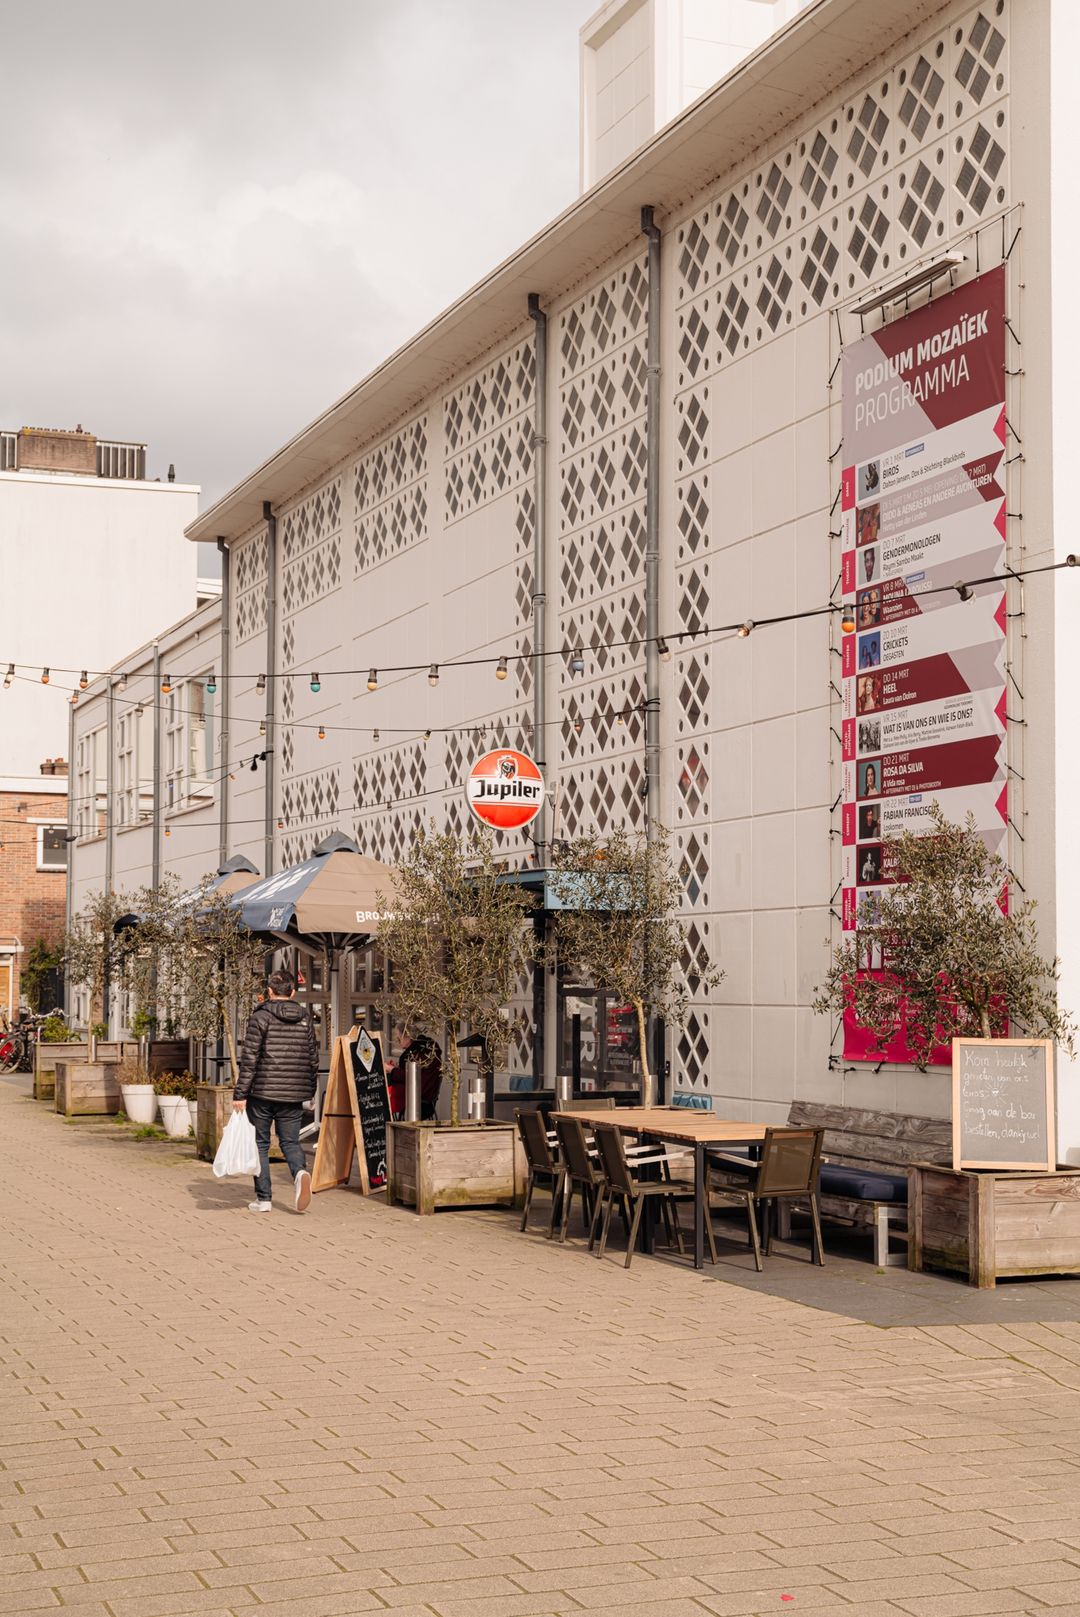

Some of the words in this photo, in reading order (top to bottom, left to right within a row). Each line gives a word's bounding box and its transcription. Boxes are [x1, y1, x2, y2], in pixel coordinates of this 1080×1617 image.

[856, 347, 913, 396] PODIUM
[917, 309, 988, 366] MOZAÏEK
[855, 354, 970, 431] PROGRAMMA
[924, 460, 943, 473] Stichting
[924, 496, 932, 508] EN
[932, 486, 955, 505] ANDERE
[955, 473, 993, 495] AVONTUREN
[883, 533, 941, 560] GENDERMONOLOGEN
[883, 636, 908, 651] CRICKETS
[883, 673, 891, 683] DO
[892, 671, 897, 681] 14
[899, 668, 909, 679] MRT
[883, 683, 897, 694] HEEL
[883, 724, 895, 734] WAT
[896, 722, 901, 732] IS
[902, 720, 915, 730] VAN
[915, 717, 928, 728] ONS
[928, 715, 937, 725] EN
[937, 712, 950, 724] WIE
[950, 711, 956, 721] IS
[957, 708, 973, 720] ONS?
[883, 756, 890, 766] DO
[891, 755, 898, 765] 21
[898, 752, 910, 763] MRT
[883, 766, 899, 777] ROSA
[899, 764, 908, 775] DA
[908, 761, 924, 774] SILVA
[473, 780, 540, 800] Jupiler
[883, 809, 904, 820] FABIAN
[965, 1049, 990, 1066] Kom
[1006, 1102, 1017, 1118] de
[1020, 1103, 1036, 1119] bar
